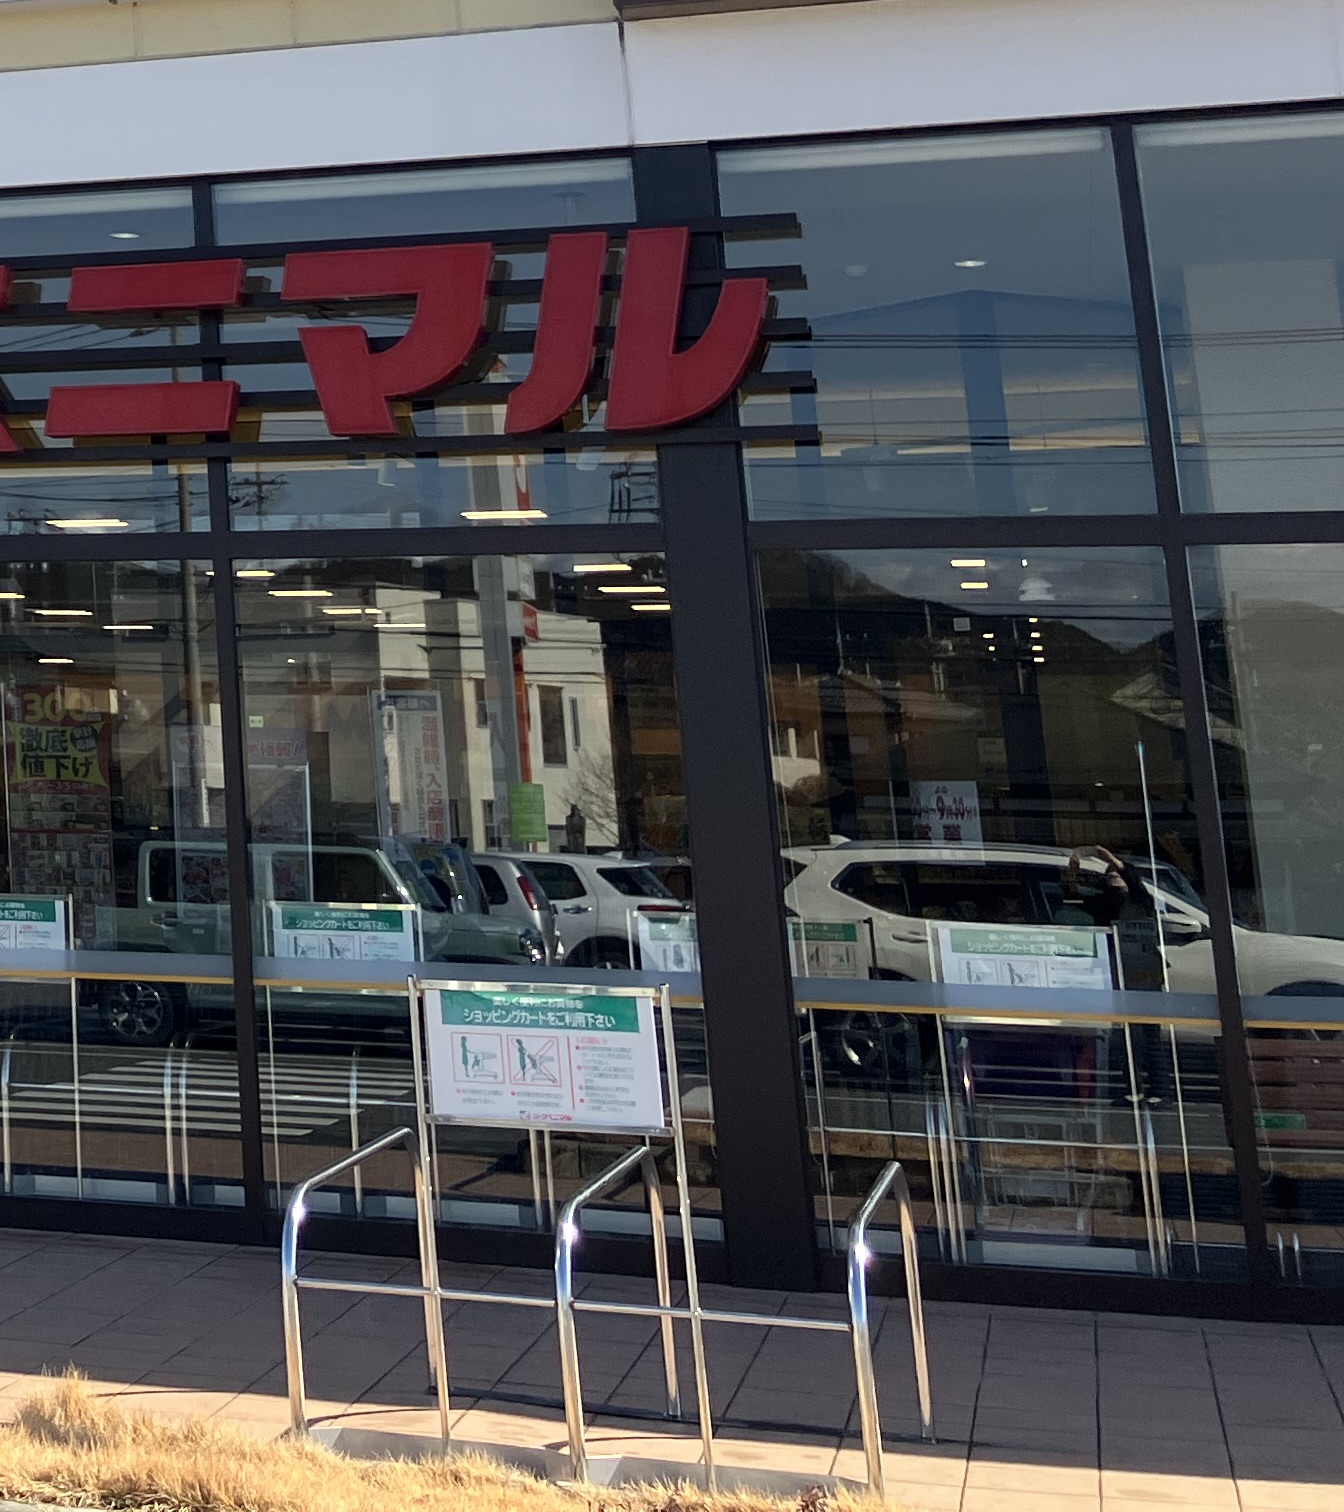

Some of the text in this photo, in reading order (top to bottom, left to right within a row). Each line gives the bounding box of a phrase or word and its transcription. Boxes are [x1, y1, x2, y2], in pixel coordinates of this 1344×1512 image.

[463, 1008, 616, 1029] ショッピングカートをご利用下さい
